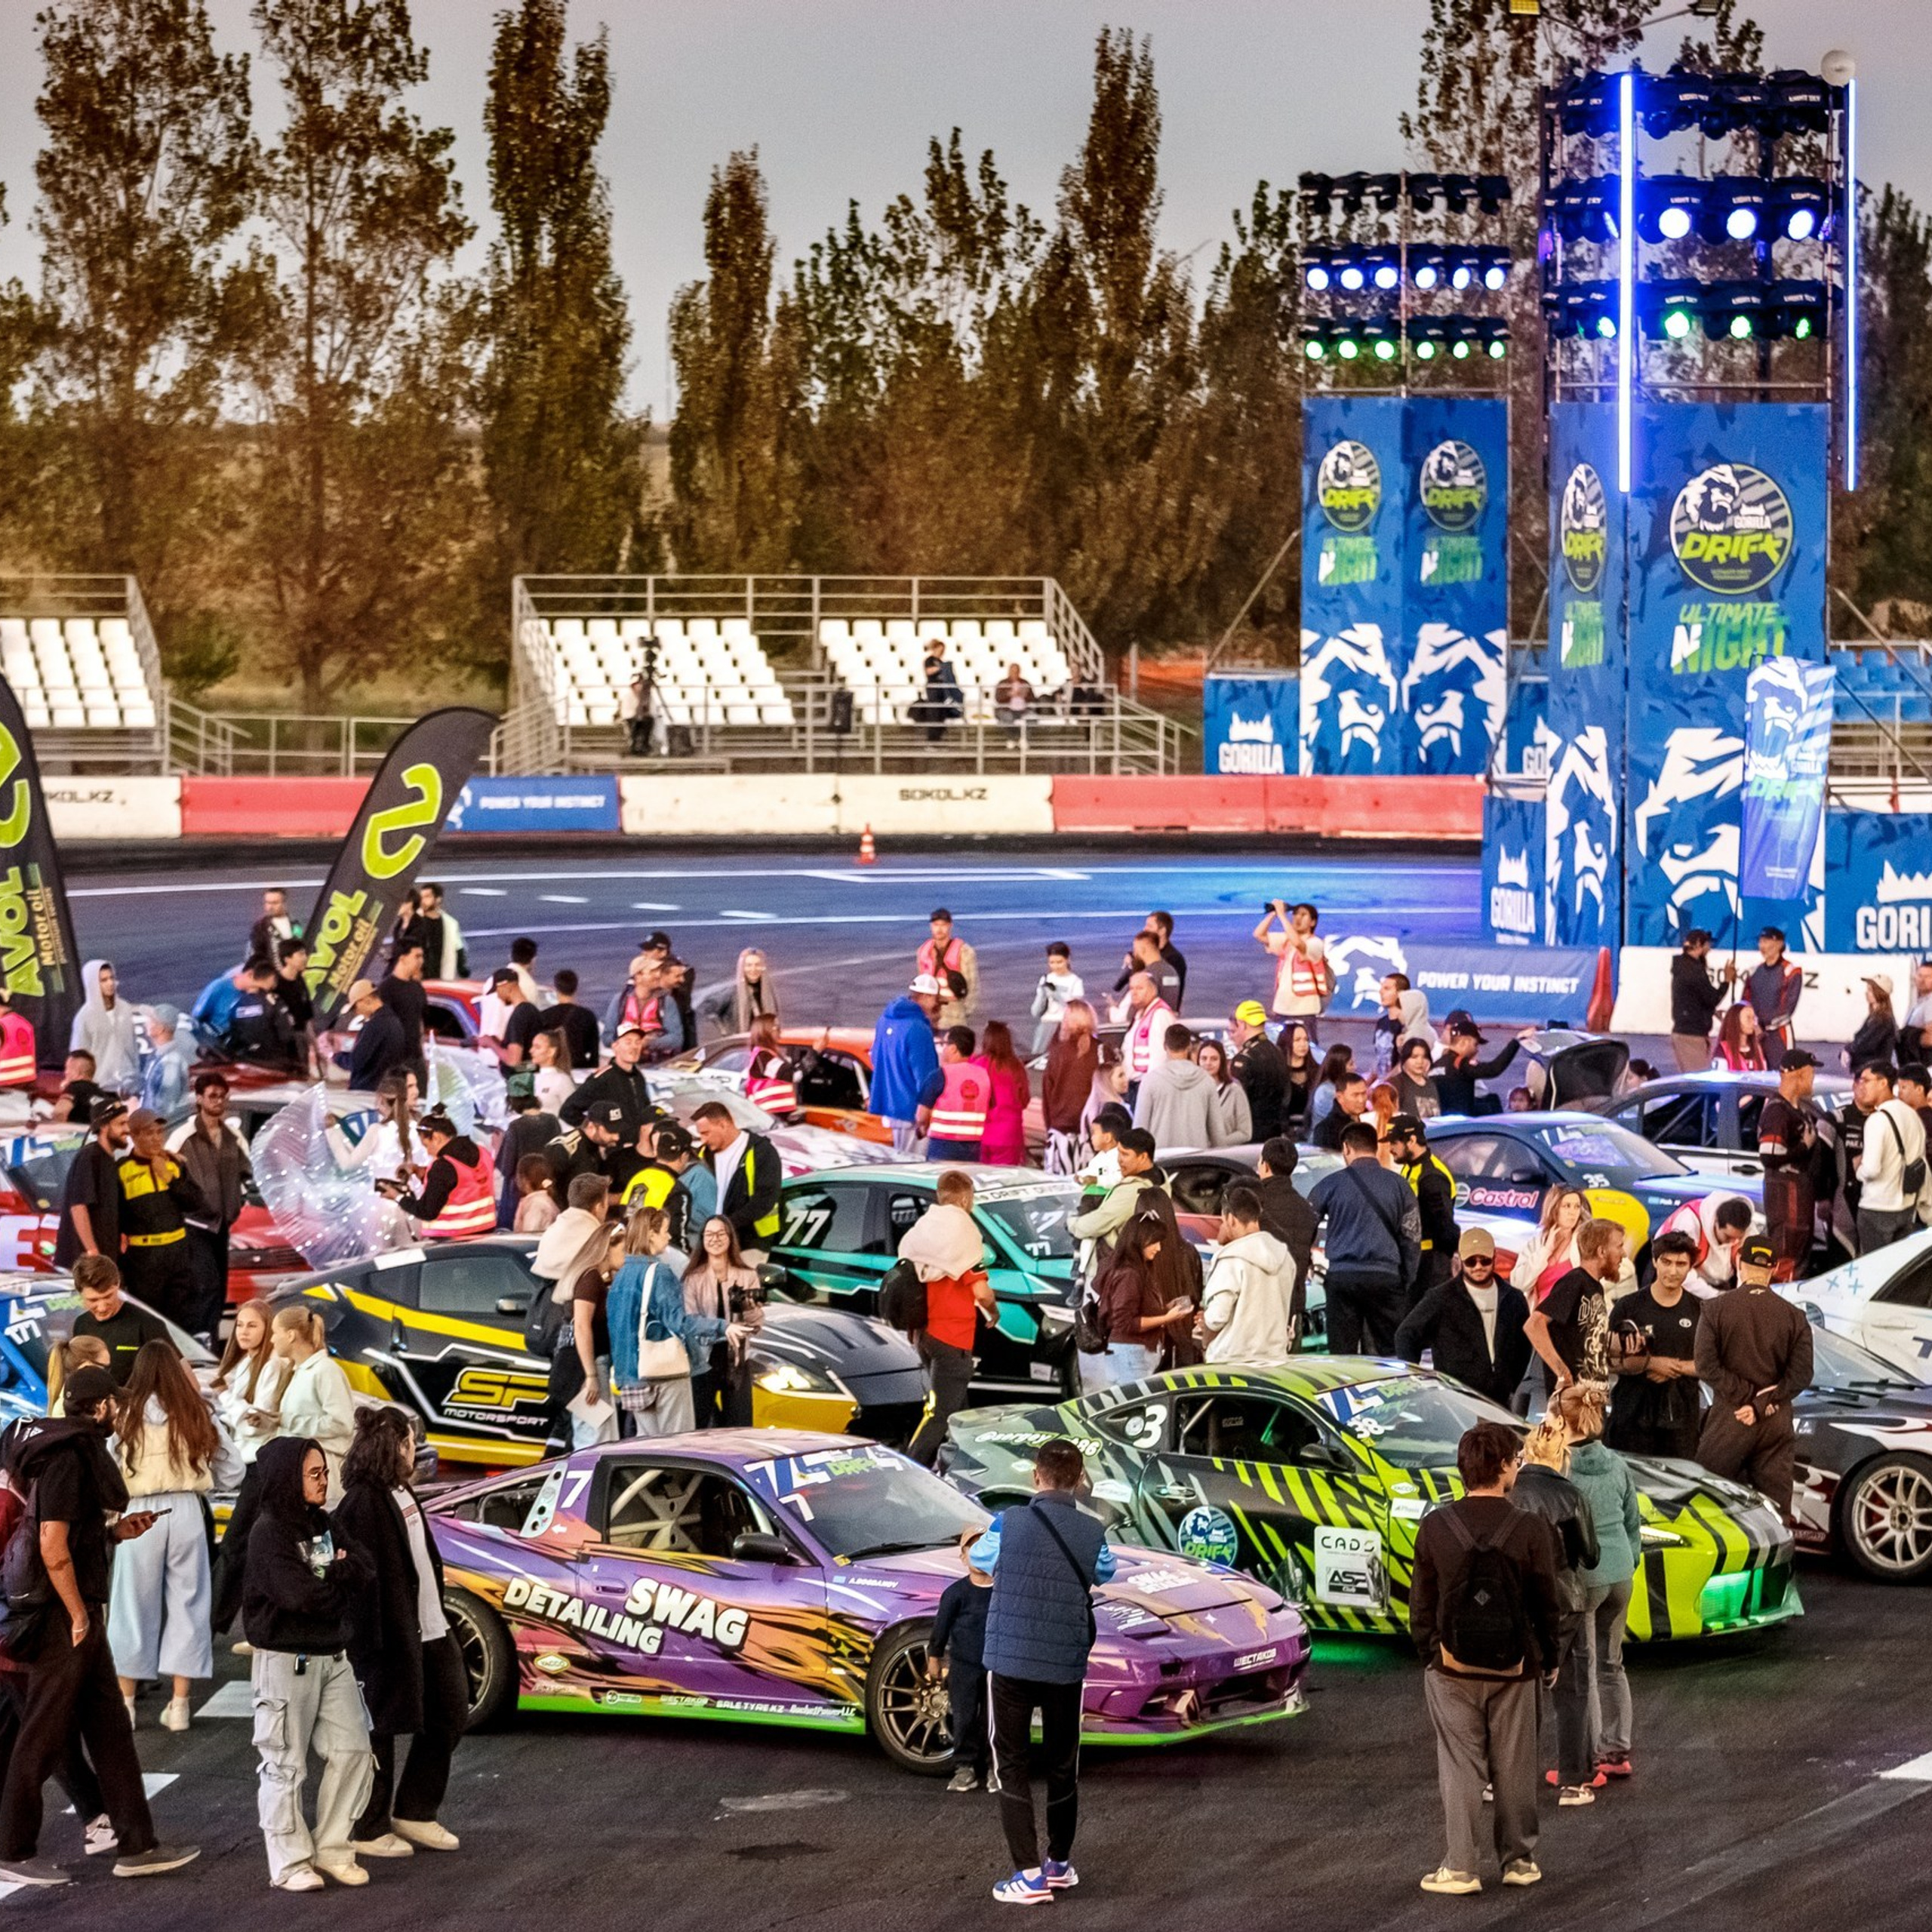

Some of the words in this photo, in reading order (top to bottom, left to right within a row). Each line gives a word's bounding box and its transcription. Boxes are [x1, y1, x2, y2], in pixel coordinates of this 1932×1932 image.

[1679, 533, 1783, 565] DRIFT
[1679, 602, 1781, 624] ULTIMATE
[1670, 620, 1787, 675] NIGHT
[1417, 971, 1470, 990] POWER
[1472, 973, 1511, 992] YOUR
[1513, 974, 1580, 995] INSTINCT
[1470, 1186, 1540, 1209] Castrol
[1583, 1174, 1611, 1189] 35
[780, 1208, 831, 1246] 77
[450, 1371, 549, 1408] SF
[442, 1407, 549, 1426] MOTORSPORT
[1346, 1417, 1386, 1438] 38
[561, 1469, 594, 1509] 7
[503, 1577, 665, 1655] DETAILING
[625, 1577, 750, 1647] SWAG
